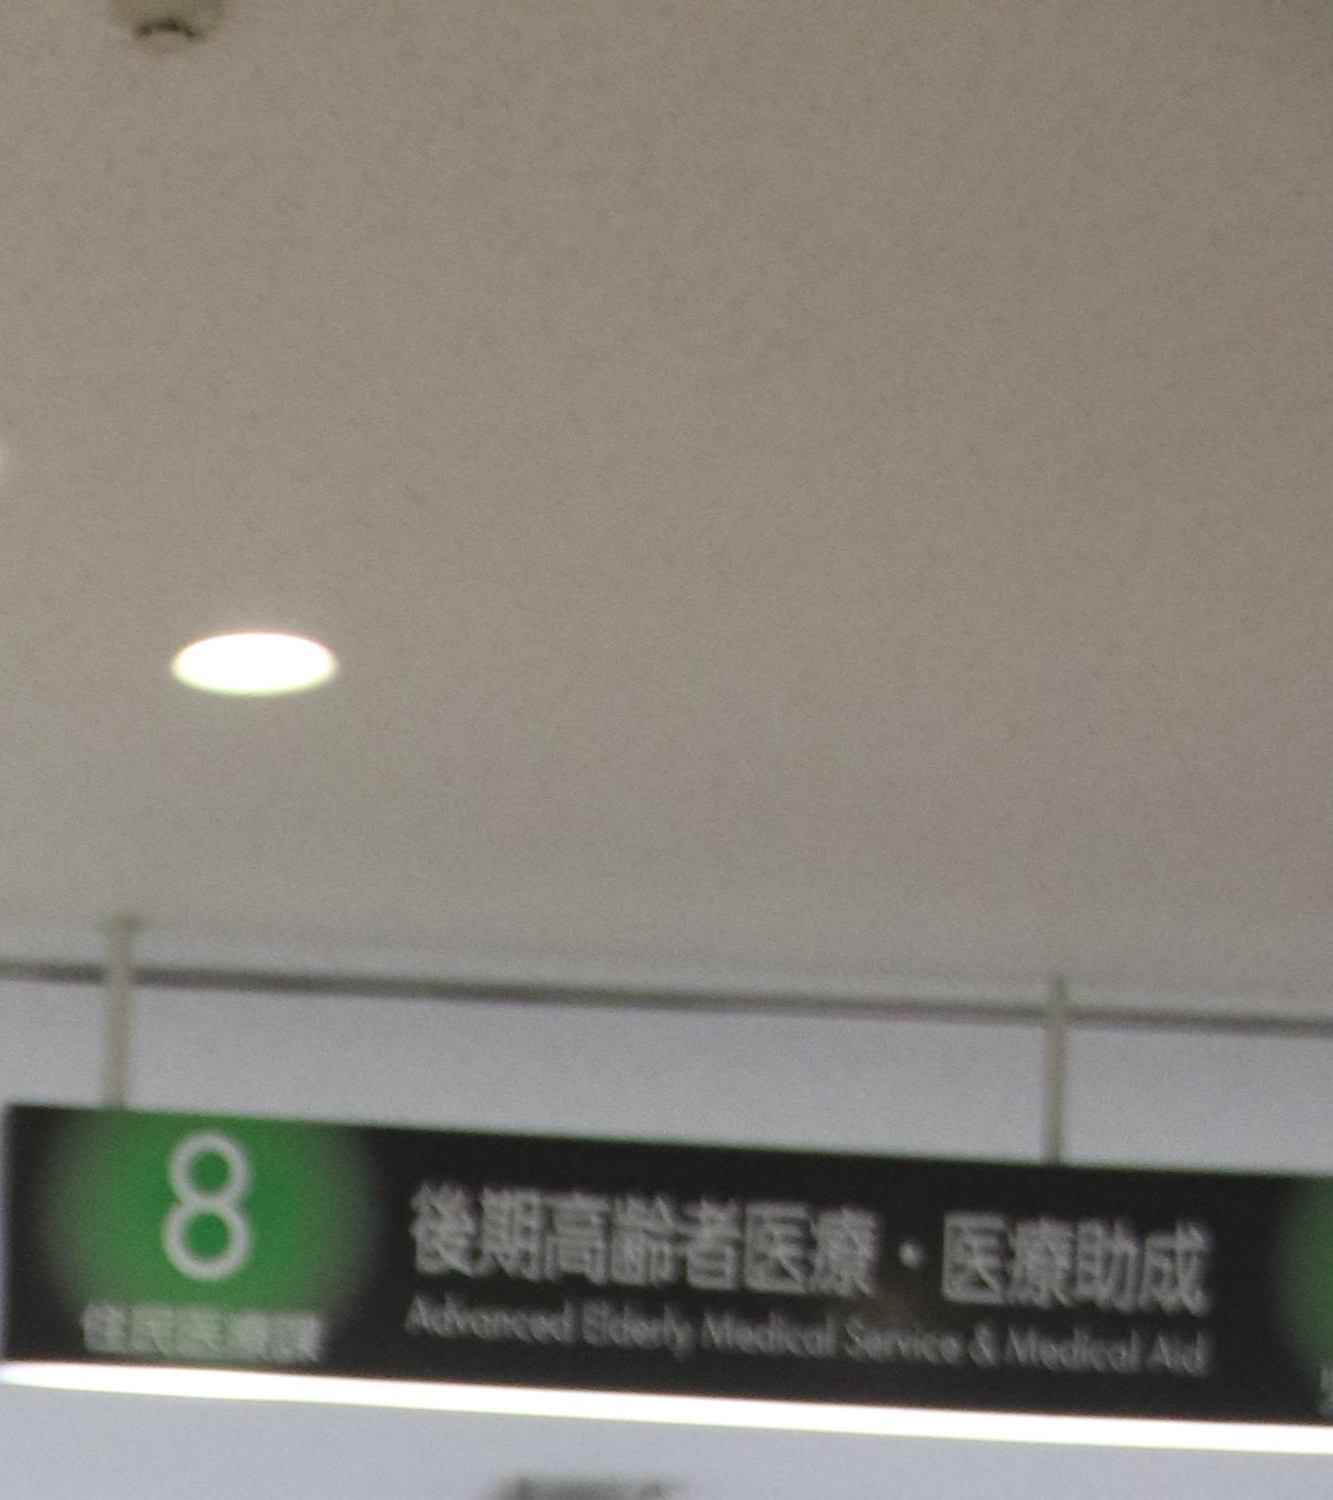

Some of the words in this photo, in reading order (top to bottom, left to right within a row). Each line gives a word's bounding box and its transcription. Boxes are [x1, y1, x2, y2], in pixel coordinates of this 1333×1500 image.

[163, 1129, 253, 1282] 8
[699, 1306, 836, 1360] Medical
[844, 1315, 965, 1366] Service
[1004, 1324, 1142, 1374] Medical
[1147, 1330, 1211, 1379] Aid
